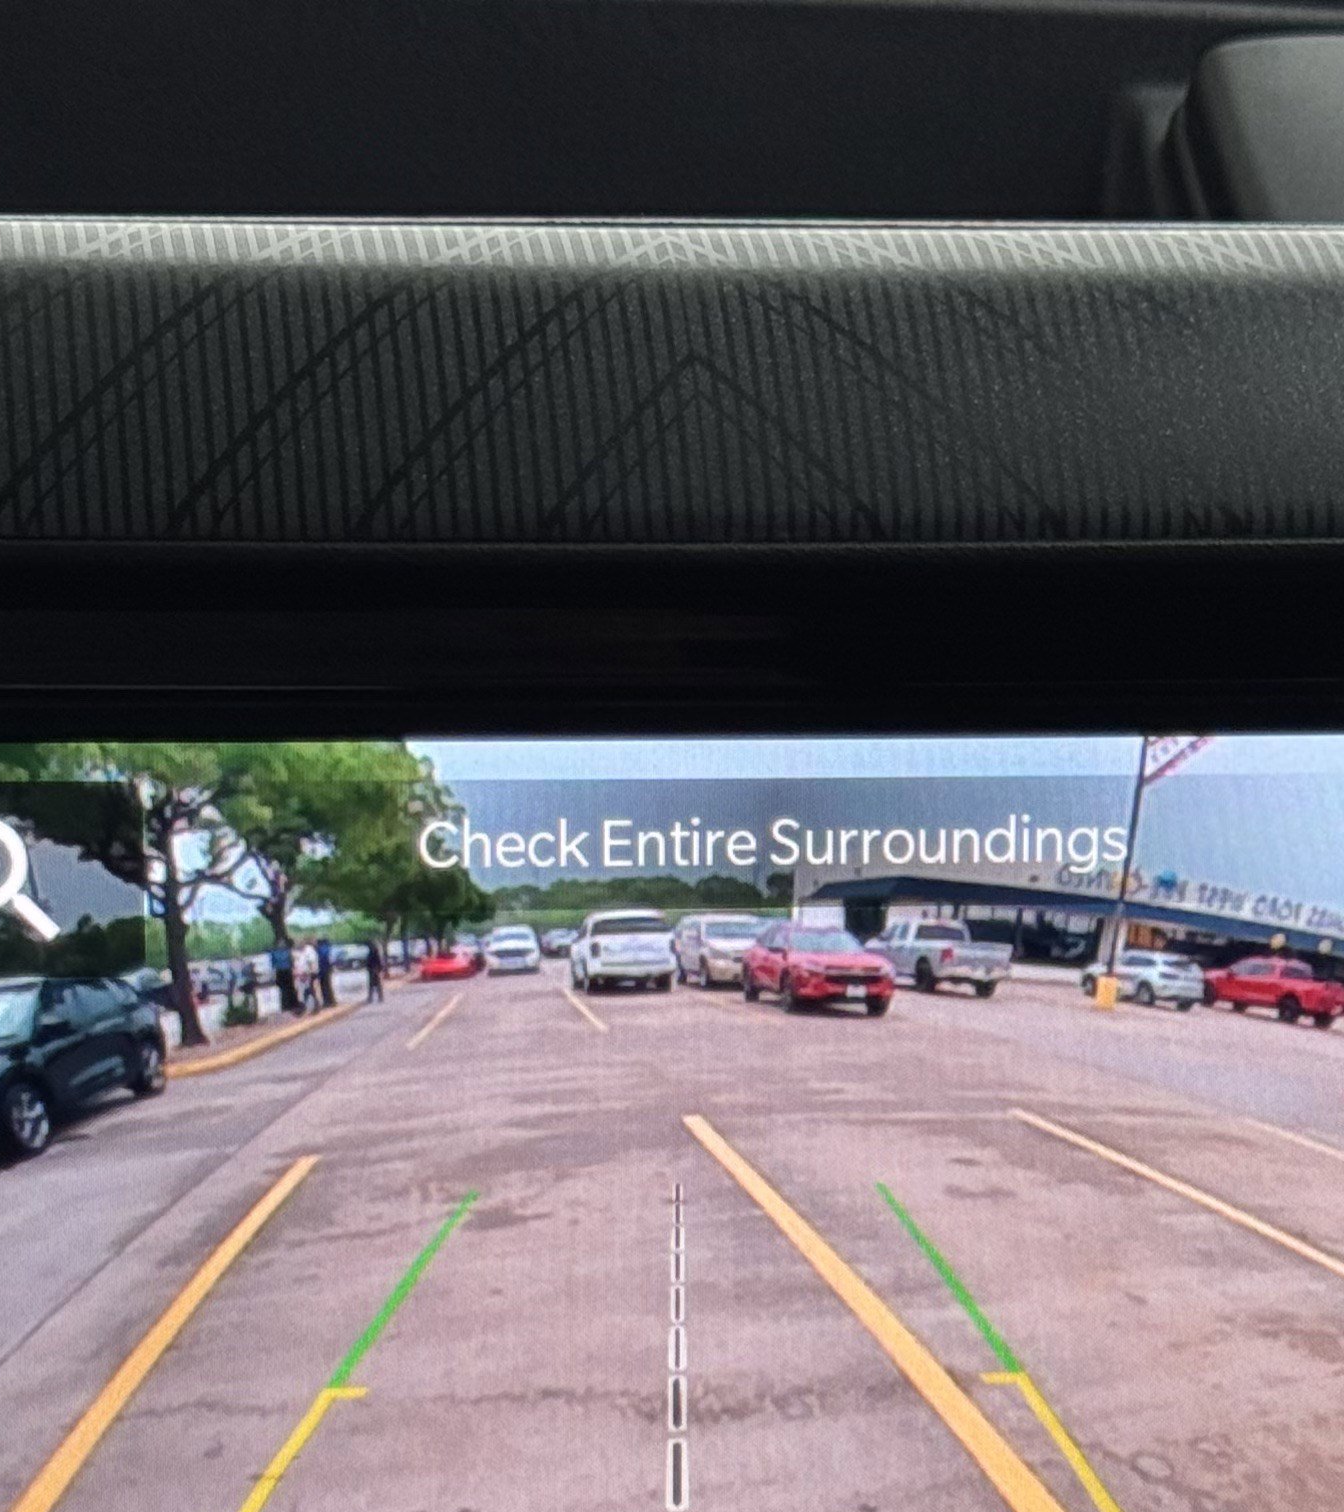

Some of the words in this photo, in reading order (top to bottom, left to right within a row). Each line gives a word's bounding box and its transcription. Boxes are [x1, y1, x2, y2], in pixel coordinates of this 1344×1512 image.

[418, 817, 588, 870] Check
[602, 815, 757, 868] Entire
[769, 814, 1128, 875] Surroundings
